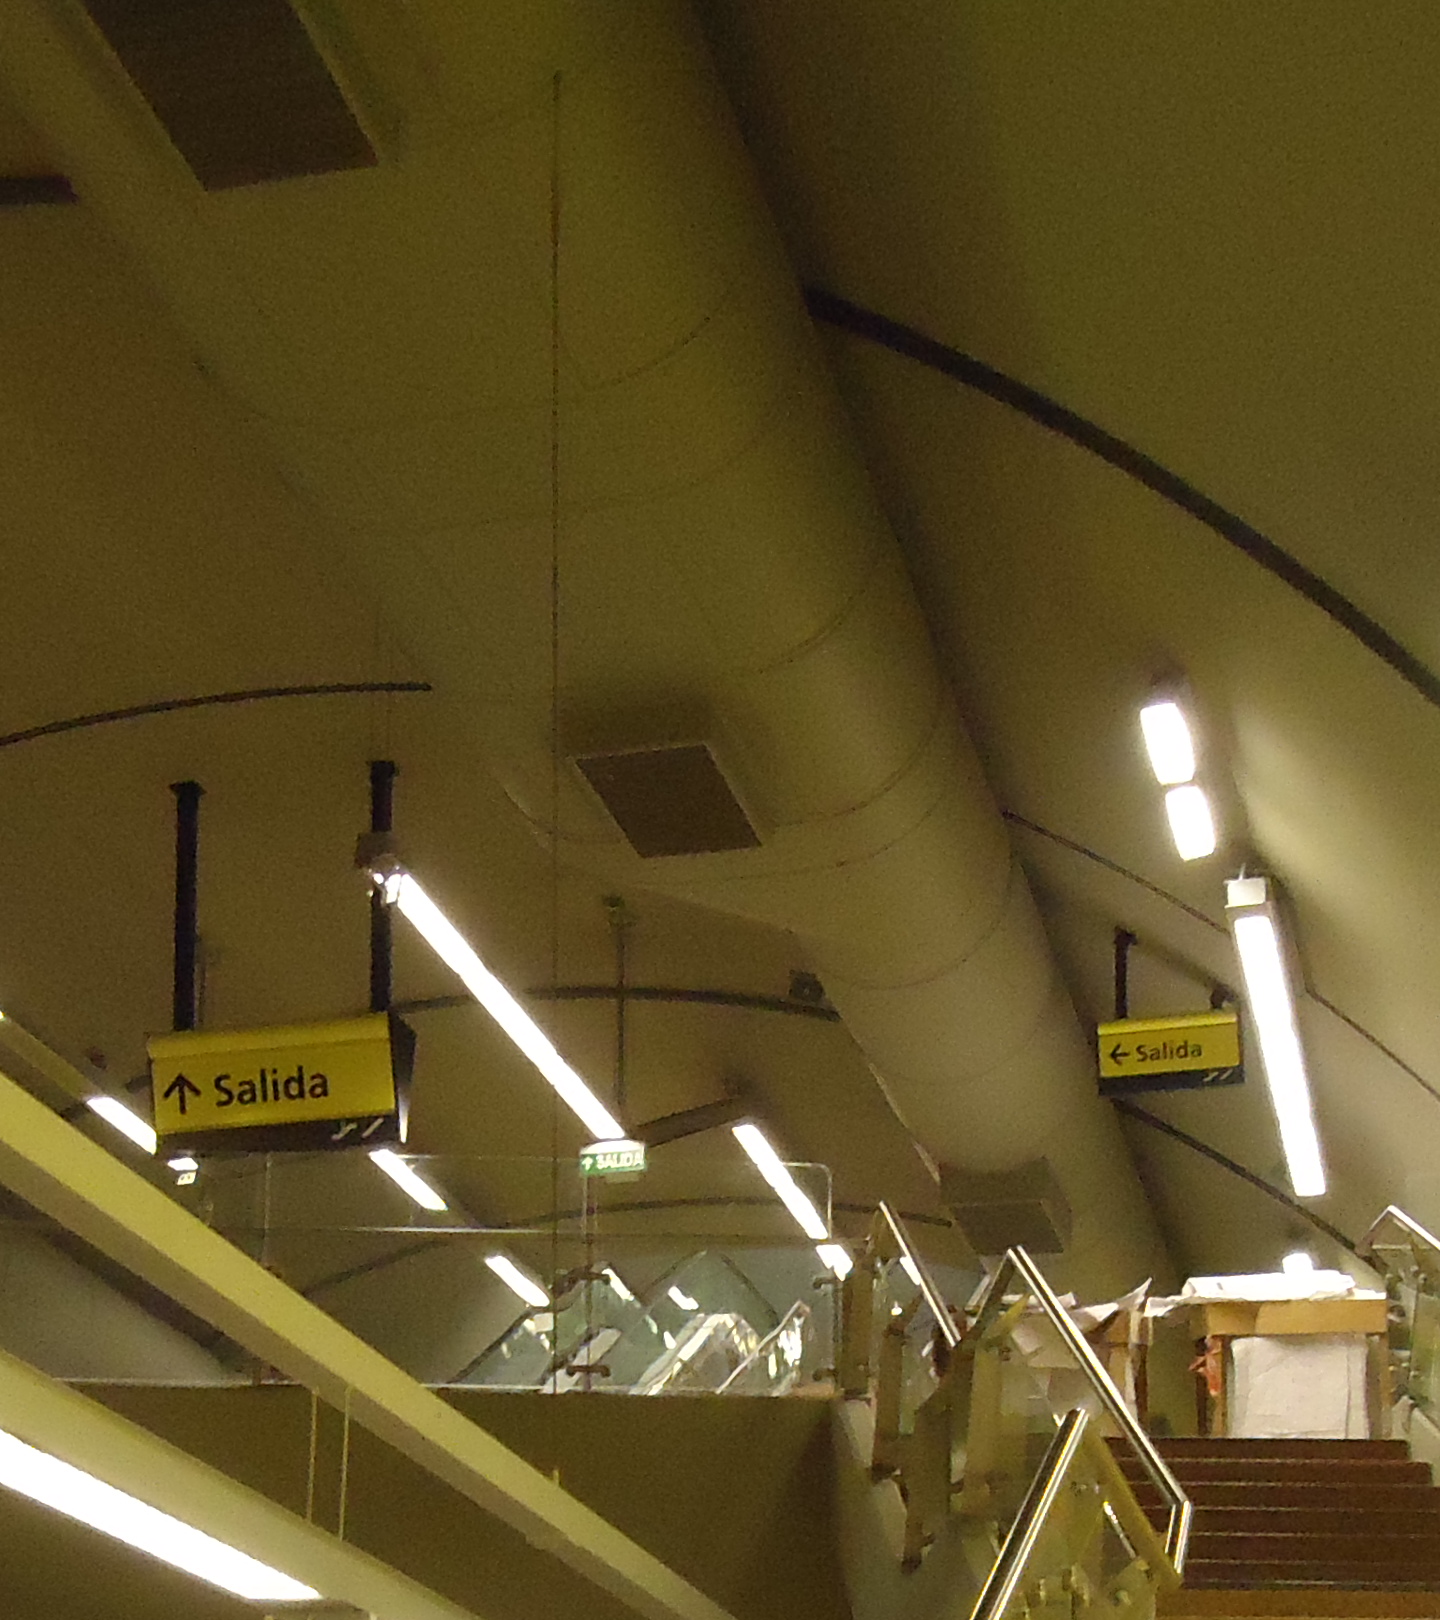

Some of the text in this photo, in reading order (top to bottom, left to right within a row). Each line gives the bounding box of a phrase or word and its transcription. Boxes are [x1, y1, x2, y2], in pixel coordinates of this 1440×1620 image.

[1136, 1039, 1202, 1063] Salida
[214, 1065, 329, 1108] Salida
[595, 1151, 643, 1170] SALIDA
